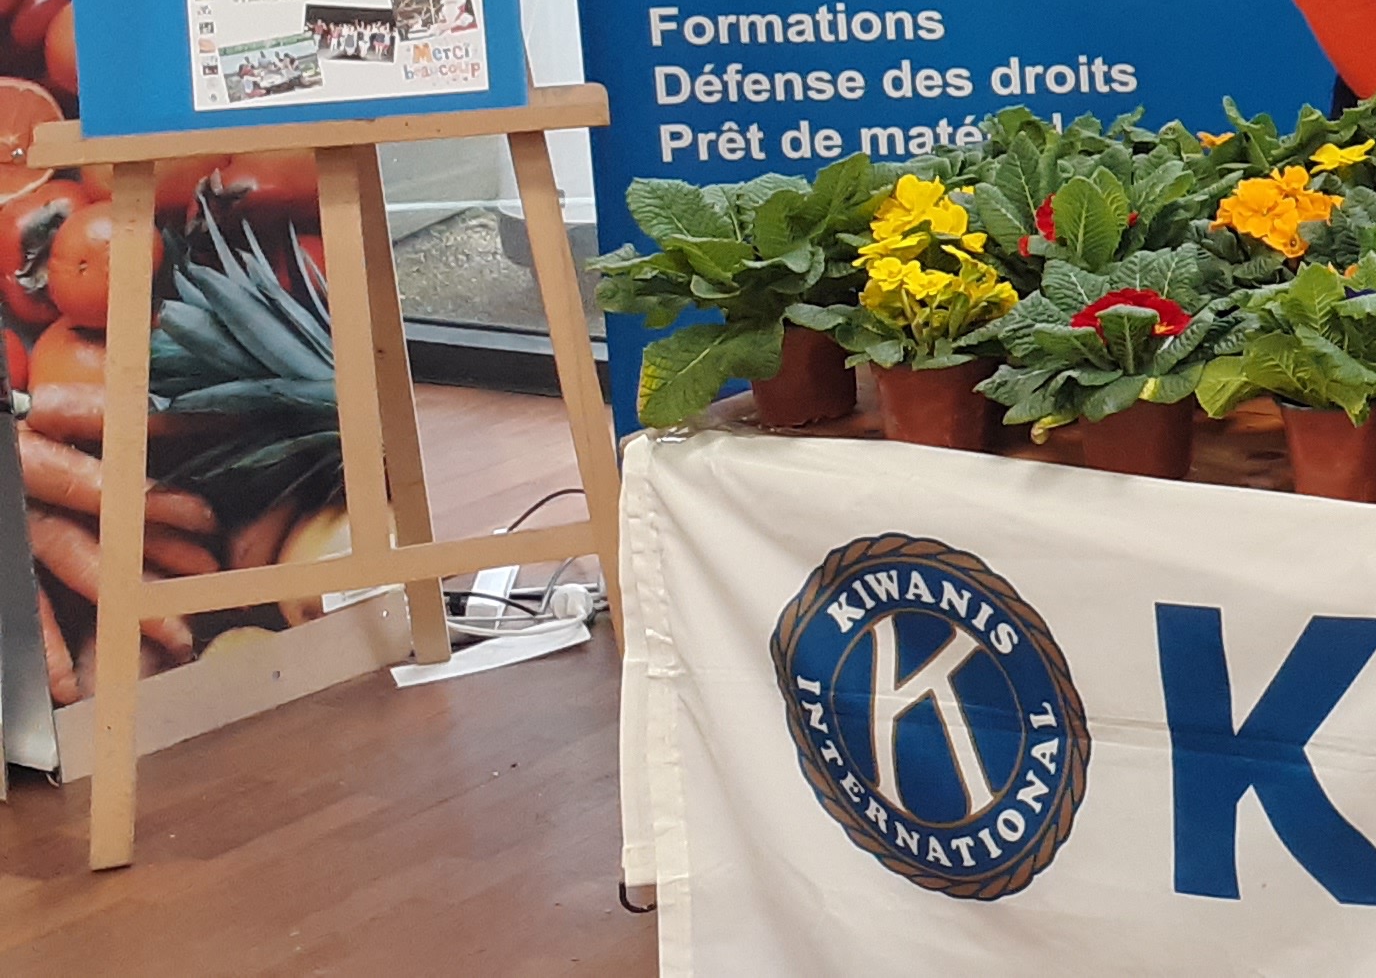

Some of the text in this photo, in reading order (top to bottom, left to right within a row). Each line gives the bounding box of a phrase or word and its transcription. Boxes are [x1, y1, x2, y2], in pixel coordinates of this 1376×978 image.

[648, 4, 946, 48] Formations
[412, 42, 470, 63] Merci
[653, 56, 1139, 106] Défense des droits
[659, 122, 766, 164] Prêt
[798, 118, 843, 159] de
[825, 569, 1020, 655] KIWANIS
[796, 673, 1060, 871] INTERNATIONAL
